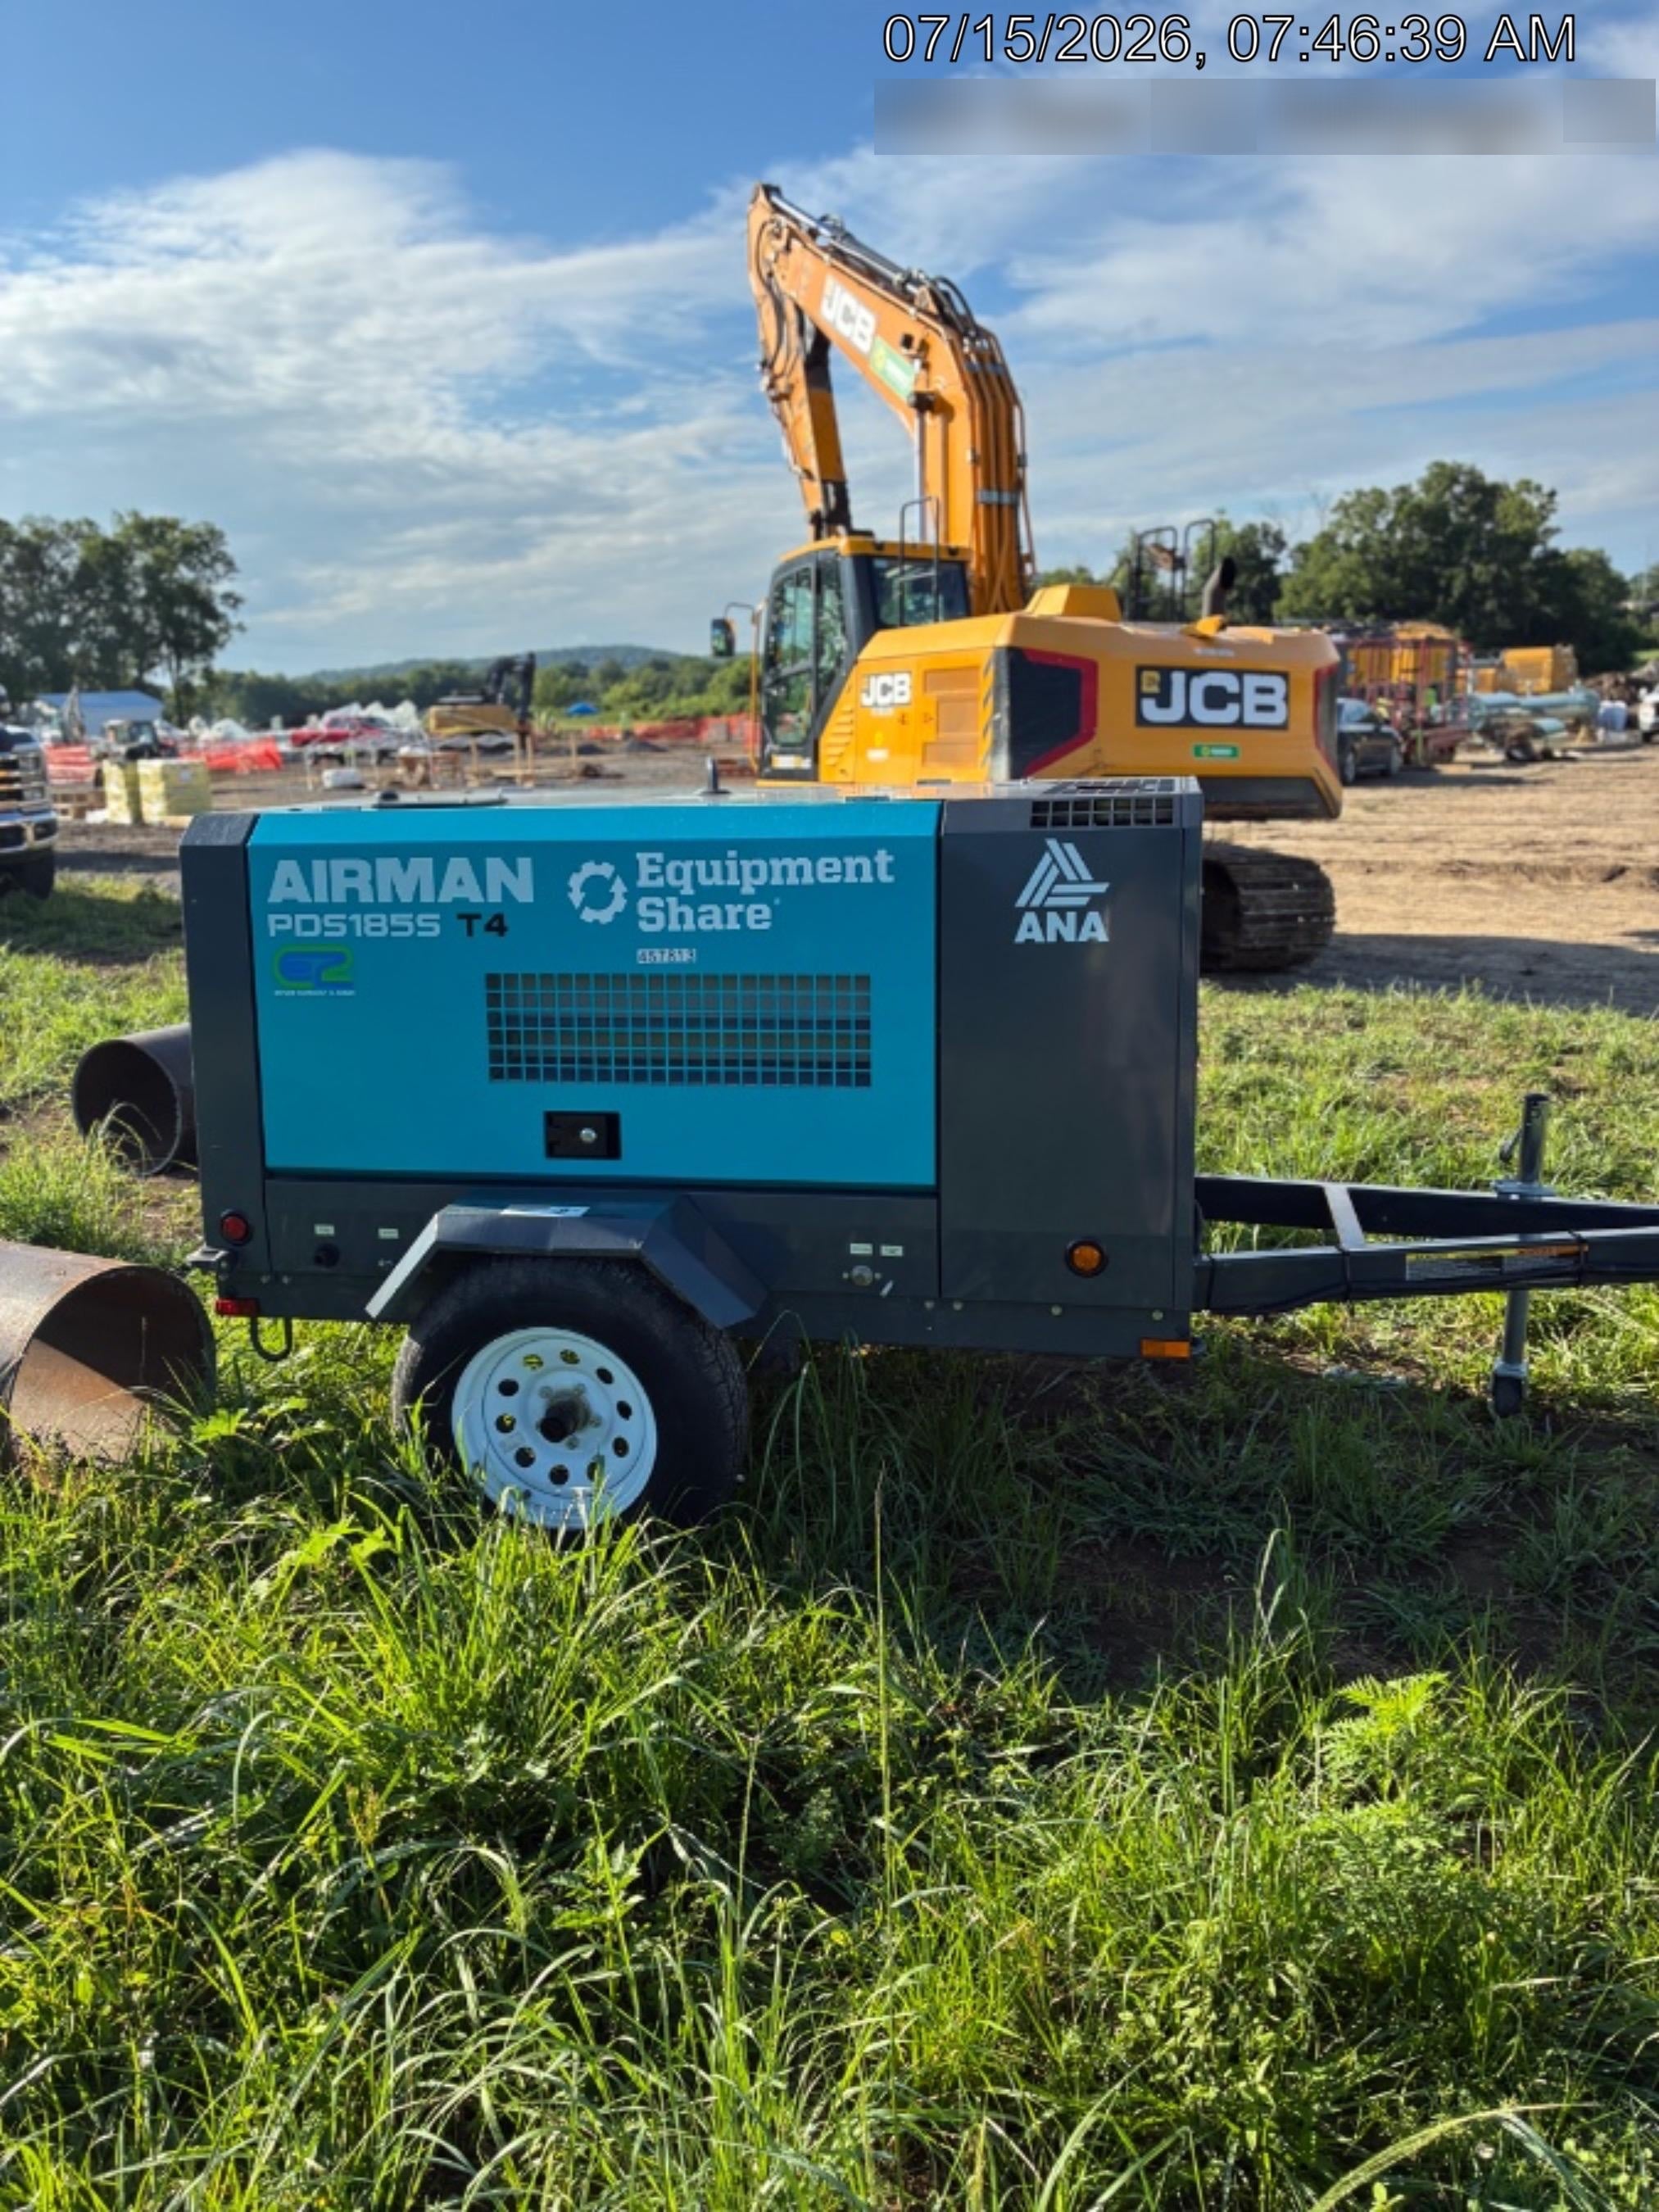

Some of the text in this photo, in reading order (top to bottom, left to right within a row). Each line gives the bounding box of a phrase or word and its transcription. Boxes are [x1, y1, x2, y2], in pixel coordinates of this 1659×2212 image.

[821, 274, 876, 356] JCB
[860, 672, 911, 707] JCB
[1140, 669, 1289, 726] JCB
[267, 857, 534, 903] AIRMAN
[636, 847, 895, 895] Equipment
[267, 912, 509, 937] PDS185S T4
[637, 895, 773, 933] Share
[1014, 910, 1109, 943] ANA
